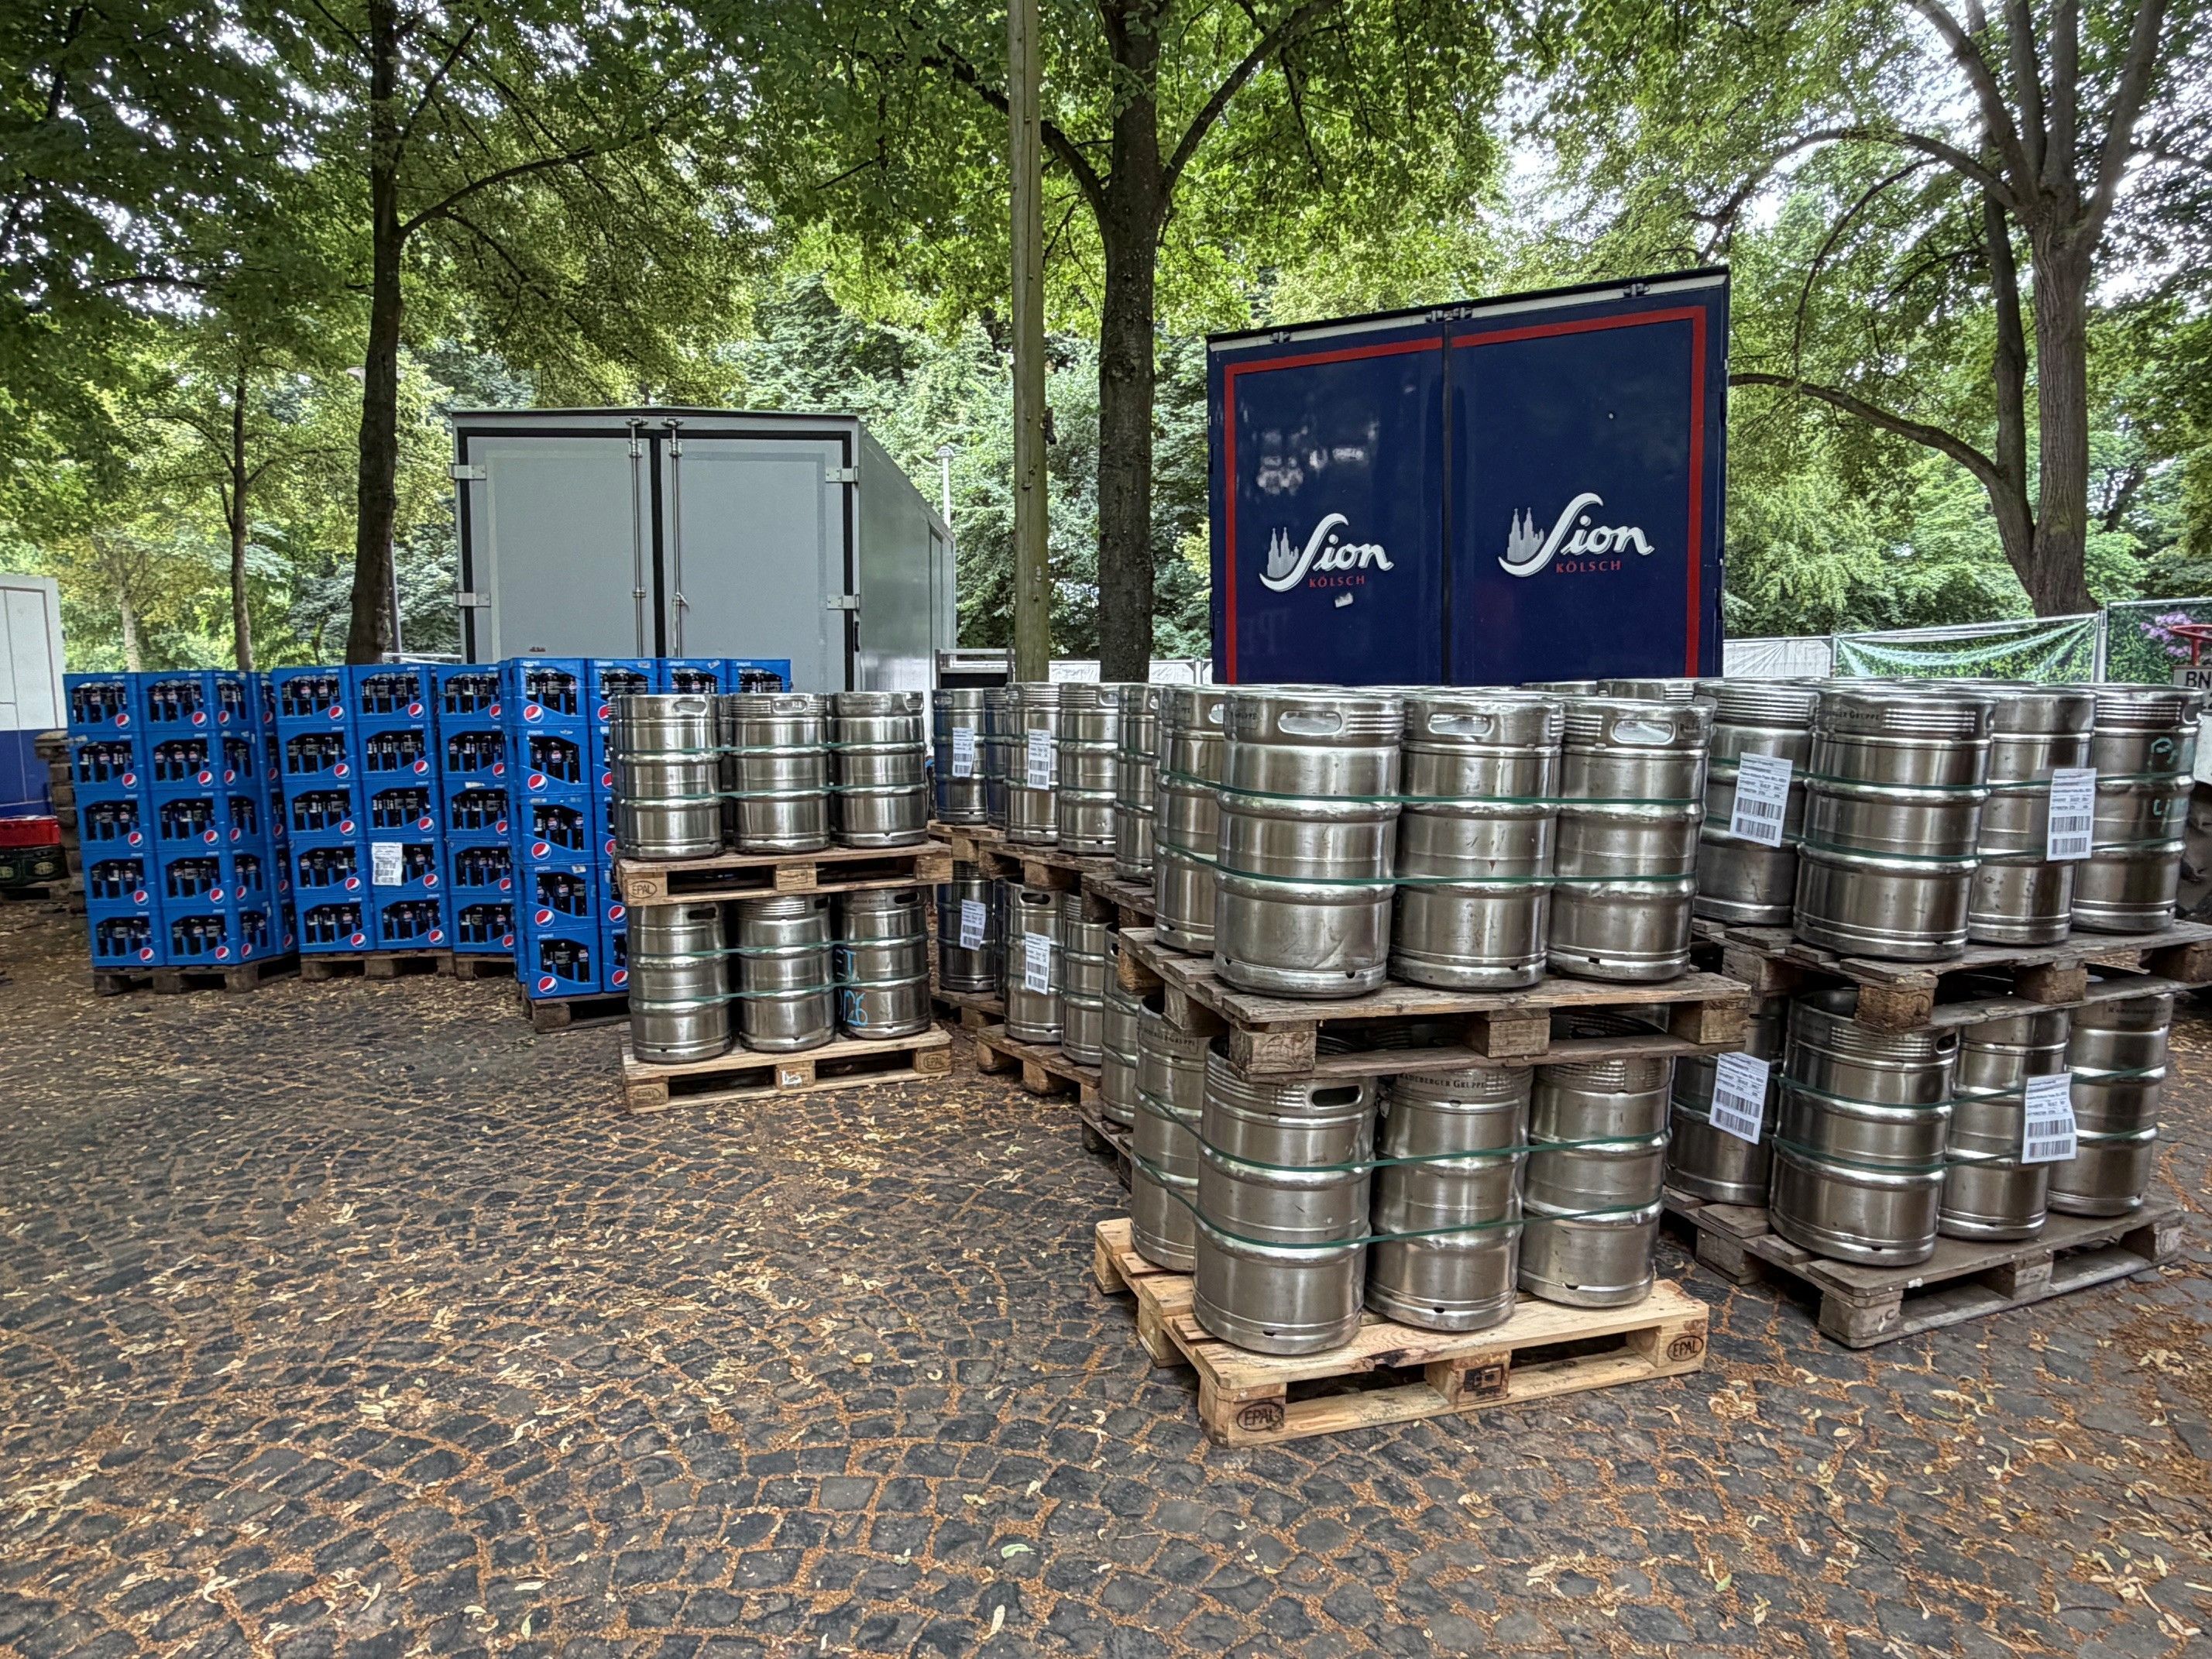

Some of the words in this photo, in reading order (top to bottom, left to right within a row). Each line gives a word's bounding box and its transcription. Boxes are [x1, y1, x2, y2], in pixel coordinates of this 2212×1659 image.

[1498, 493, 1655, 577] Sion
[1259, 513, 1394, 592] Sion
[1556, 560, 1622, 573] KÖLSCH
[1309, 575, 1365, 588] KÖLSCH
[1673, 1341, 1697, 1357] EPAL
